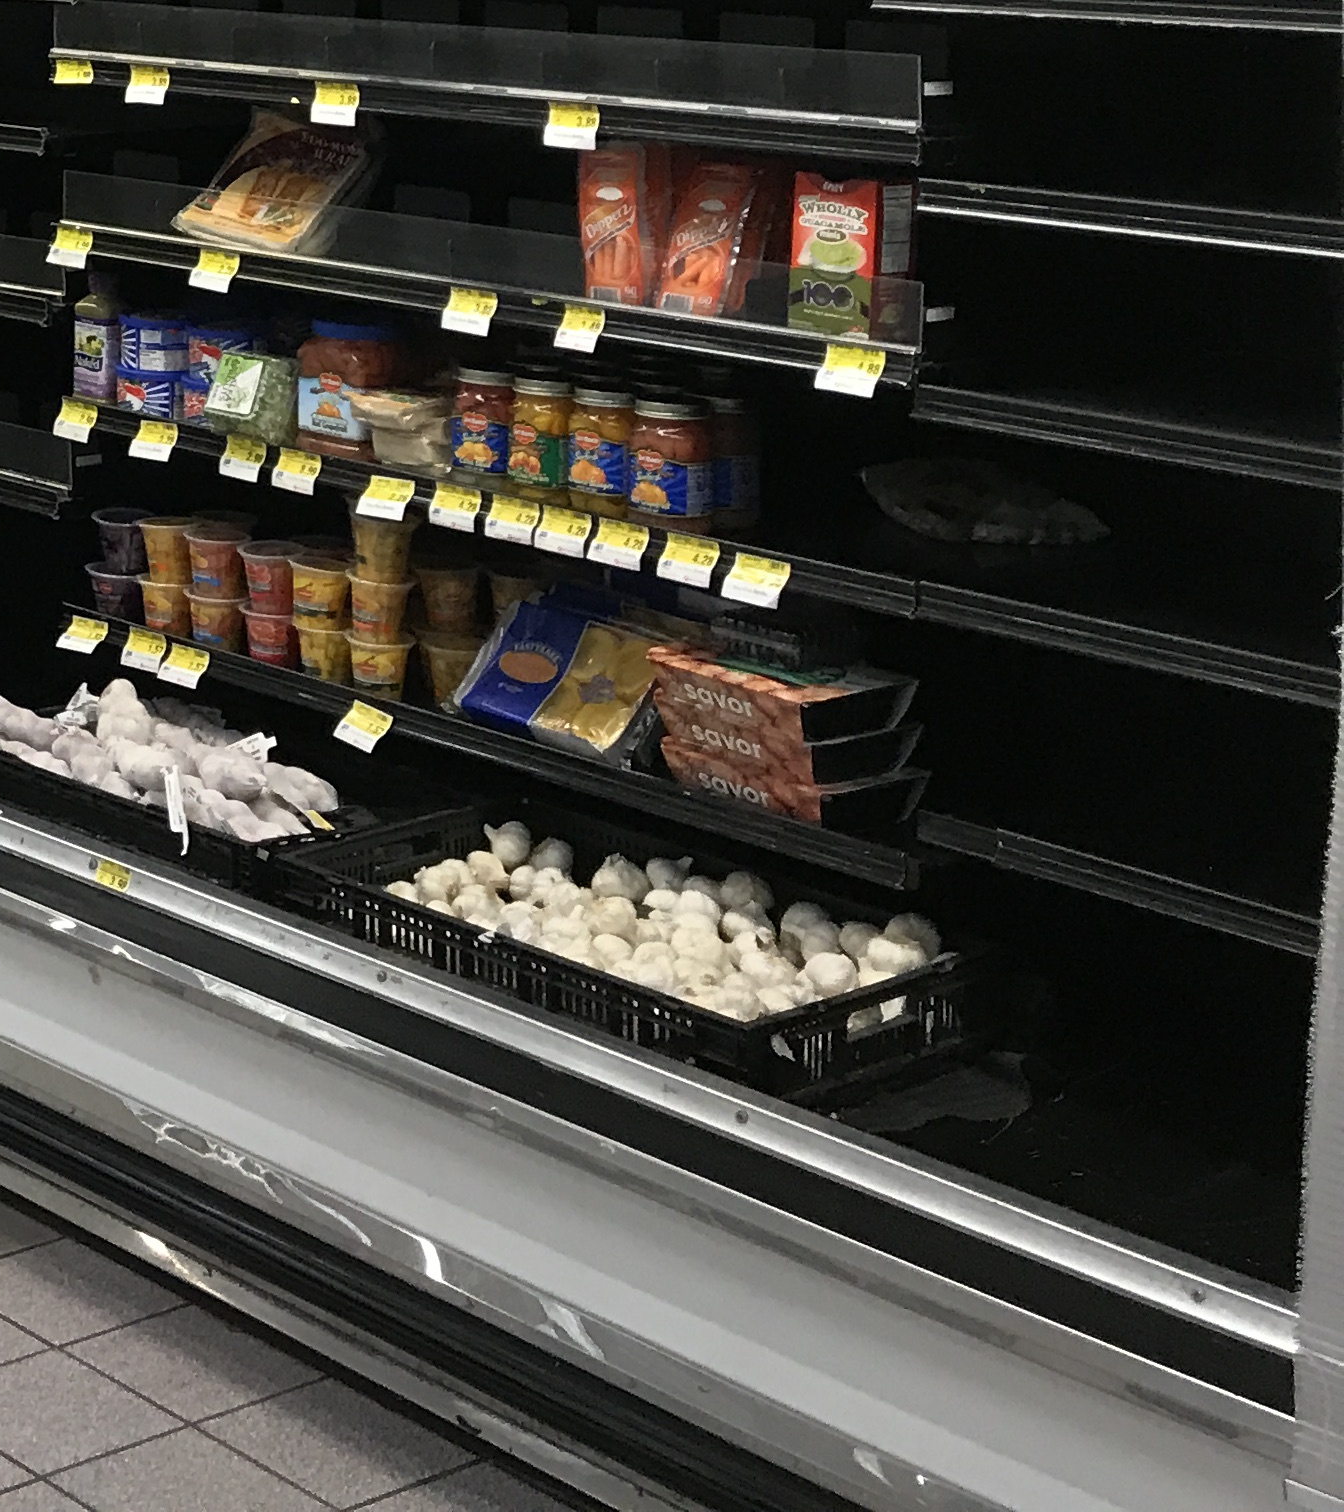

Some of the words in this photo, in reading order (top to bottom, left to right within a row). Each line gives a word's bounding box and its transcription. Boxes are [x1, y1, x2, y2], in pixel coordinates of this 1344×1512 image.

[801, 202, 867, 222] WHOLLY
[684, 683, 753, 717] savor
[691, 724, 762, 759] savor
[698, 772, 770, 808] savor
